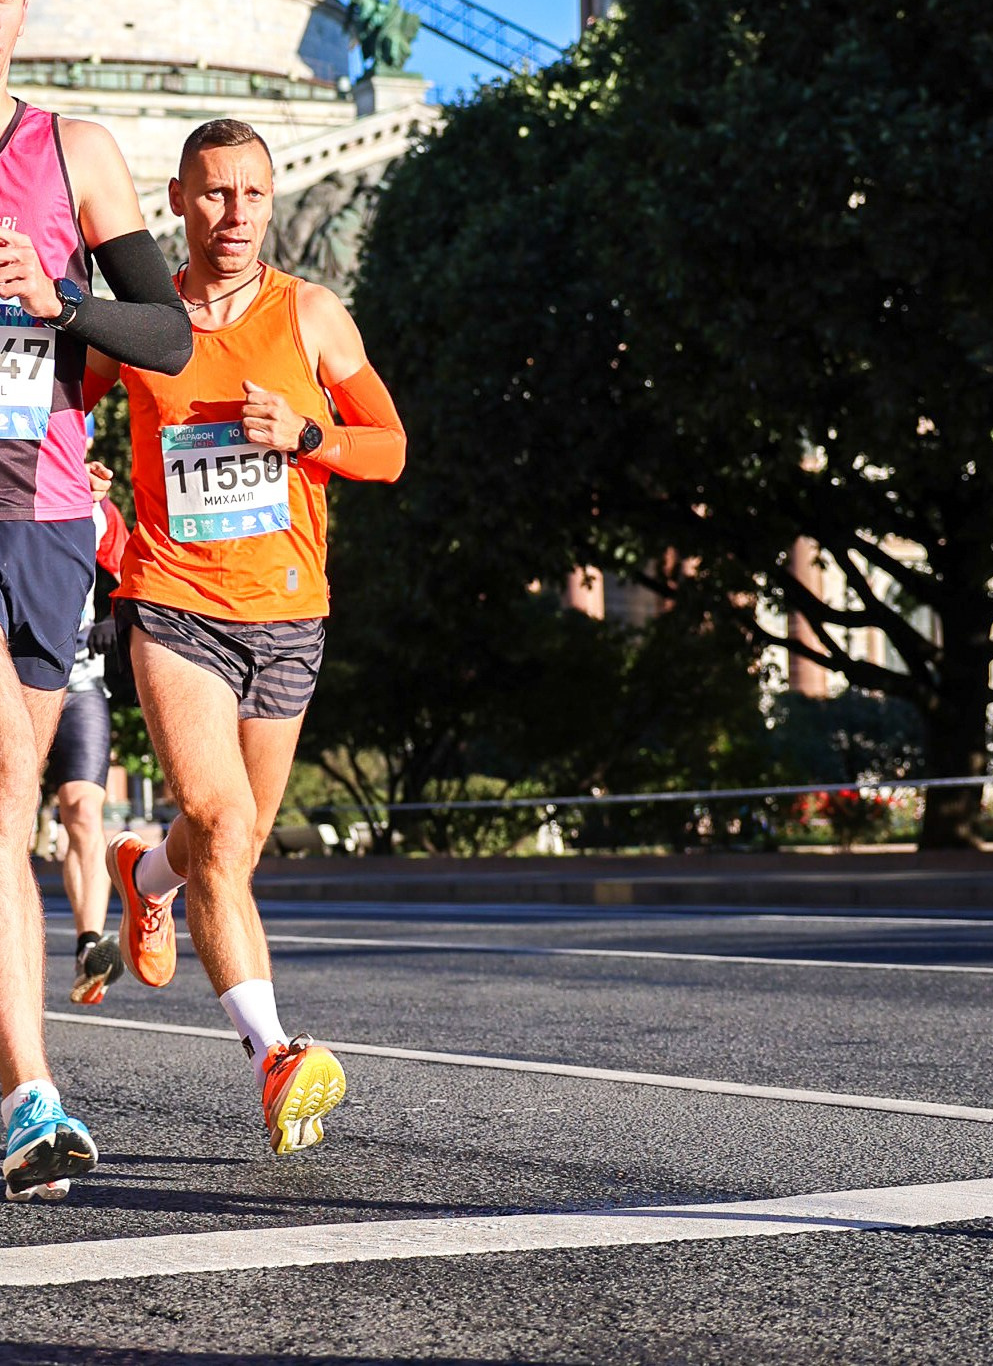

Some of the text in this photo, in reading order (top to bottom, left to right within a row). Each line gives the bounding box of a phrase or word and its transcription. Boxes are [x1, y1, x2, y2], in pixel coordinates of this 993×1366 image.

[174, 432, 214, 442] МАРАФОН
[228, 428, 240, 438] 10
[171, 449, 283, 494] 11550
[204, 491, 255, 507] МИХАИЛ
